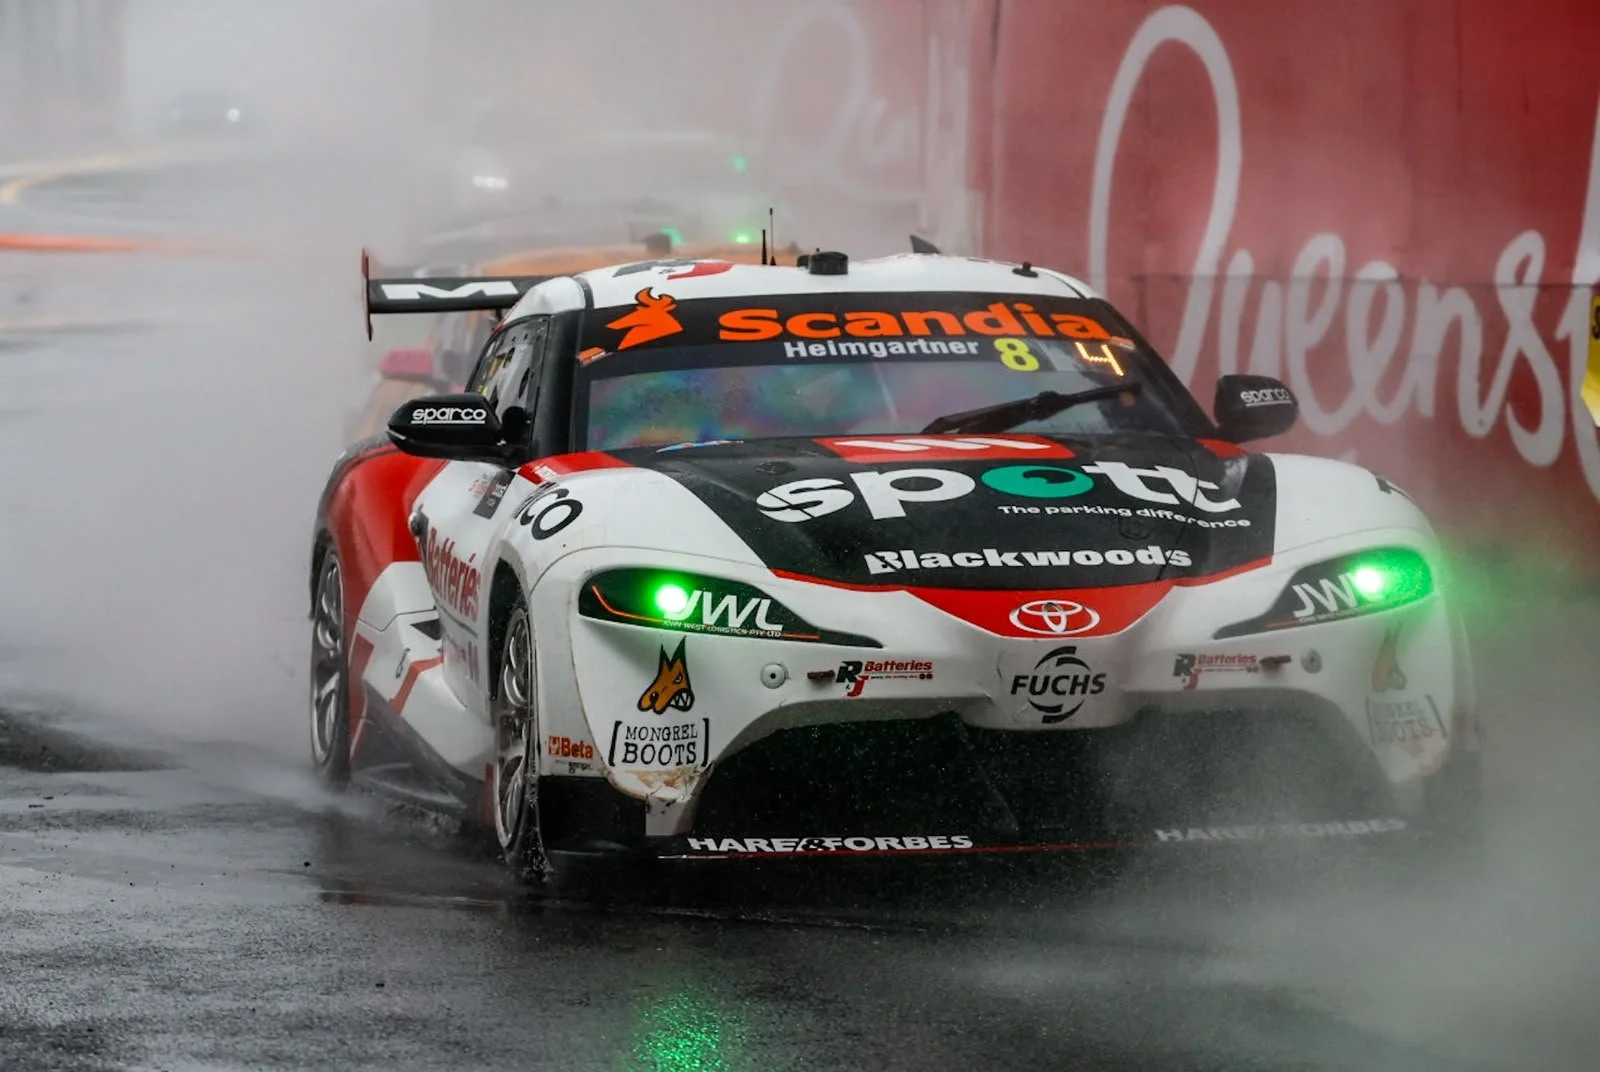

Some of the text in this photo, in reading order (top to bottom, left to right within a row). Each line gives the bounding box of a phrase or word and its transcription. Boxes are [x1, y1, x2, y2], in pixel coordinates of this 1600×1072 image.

[718, 302, 1112, 341] Scandia
[784, 337, 1040, 372] Heimgartner 8
[1074, 341, 1125, 377] 4
[411, 407, 487, 425] sparco
[755, 460, 1242, 523] spott
[998, 505, 1251, 528] The parking difference
[864, 546, 1192, 575] Blackwoods
[663, 589, 784, 632] JWL
[864, 660, 933, 672] Batteries
[1010, 673, 1107, 695] FUCHS
[625, 724, 698, 741] MONGREL
[561, 736, 594, 759] Beta
[622, 742, 697, 766] BOOTS
